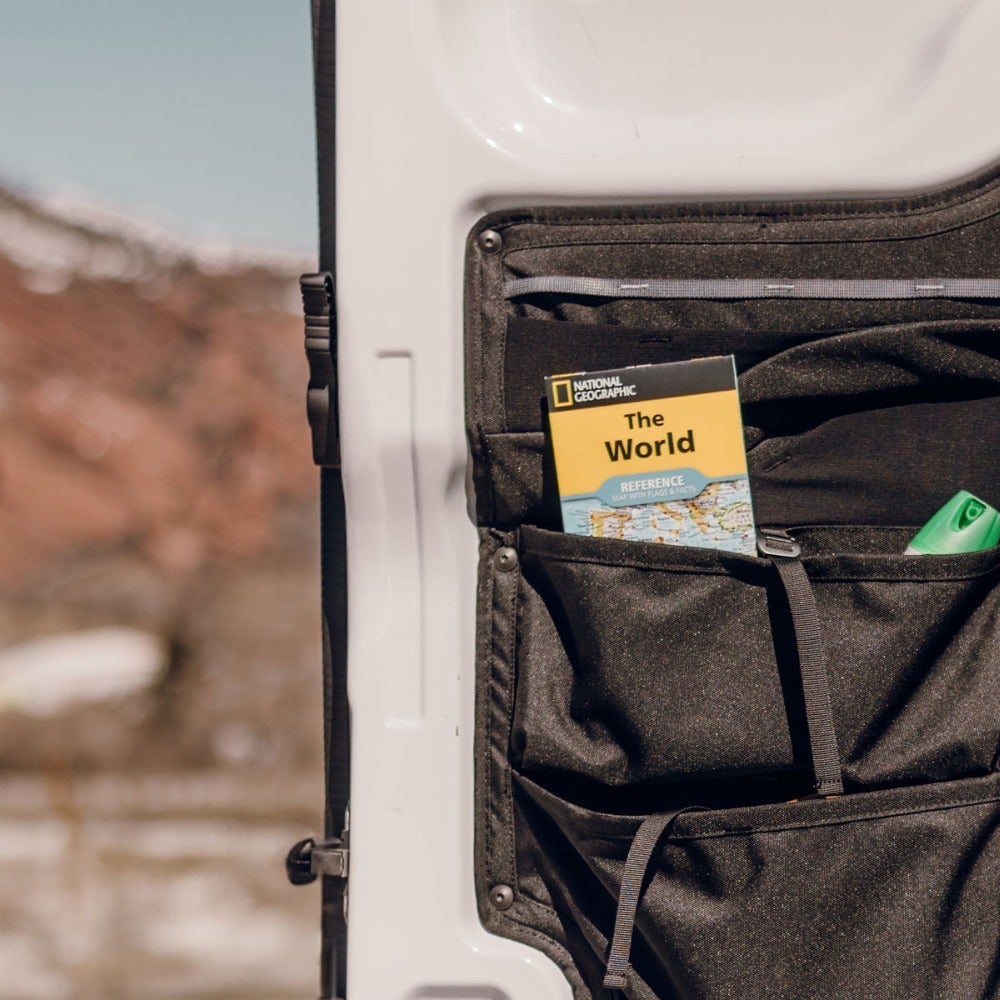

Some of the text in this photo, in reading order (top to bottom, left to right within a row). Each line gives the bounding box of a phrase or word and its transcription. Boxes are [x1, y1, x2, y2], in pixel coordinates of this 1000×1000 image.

[573, 376, 623, 392] NATIONAL
[574, 385, 637, 403] GEOGRAPHIC
[624, 411, 665, 430] The
[605, 429, 696, 462] World
[620, 475, 685, 493] REFERENCE
